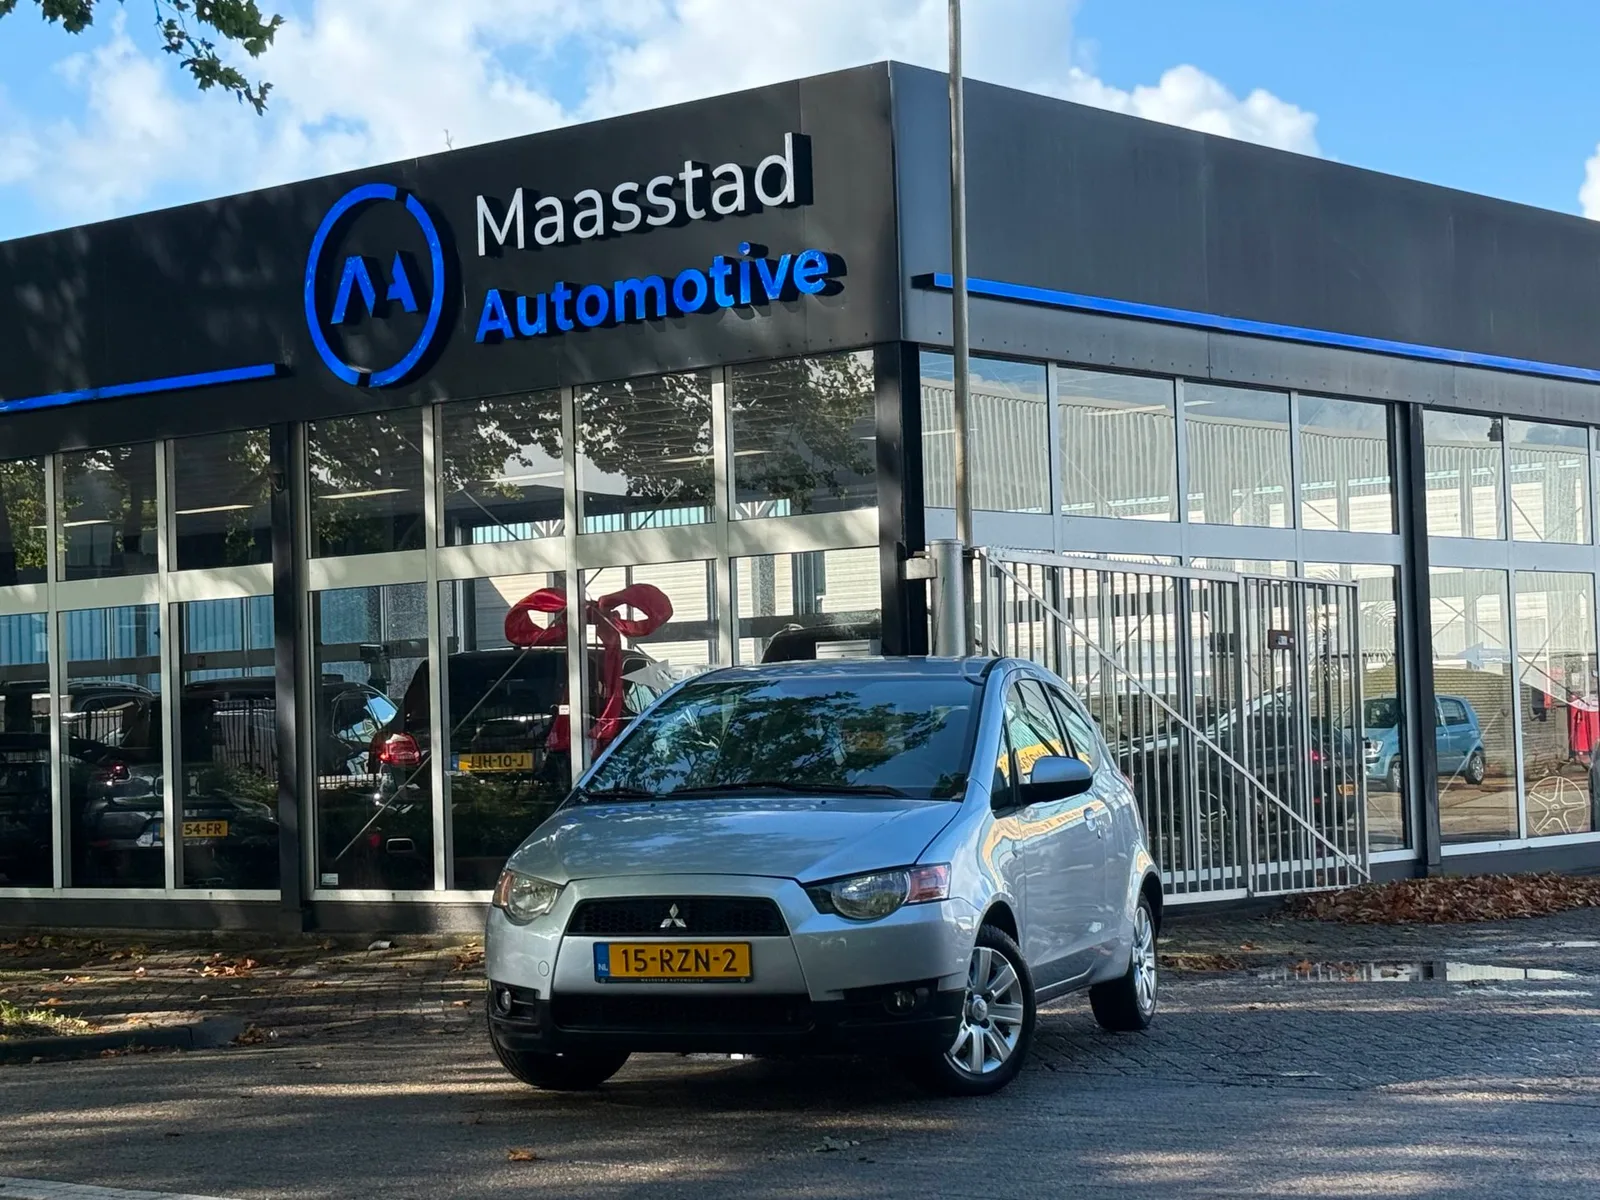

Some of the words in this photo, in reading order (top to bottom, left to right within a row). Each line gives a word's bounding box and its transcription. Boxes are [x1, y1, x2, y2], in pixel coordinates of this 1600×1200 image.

[475, 131, 796, 257] Maasstad
[475, 241, 830, 344] Automotive
[597, 962, 609, 972] NL
[621, 947, 738, 973] 15-RZN-2
